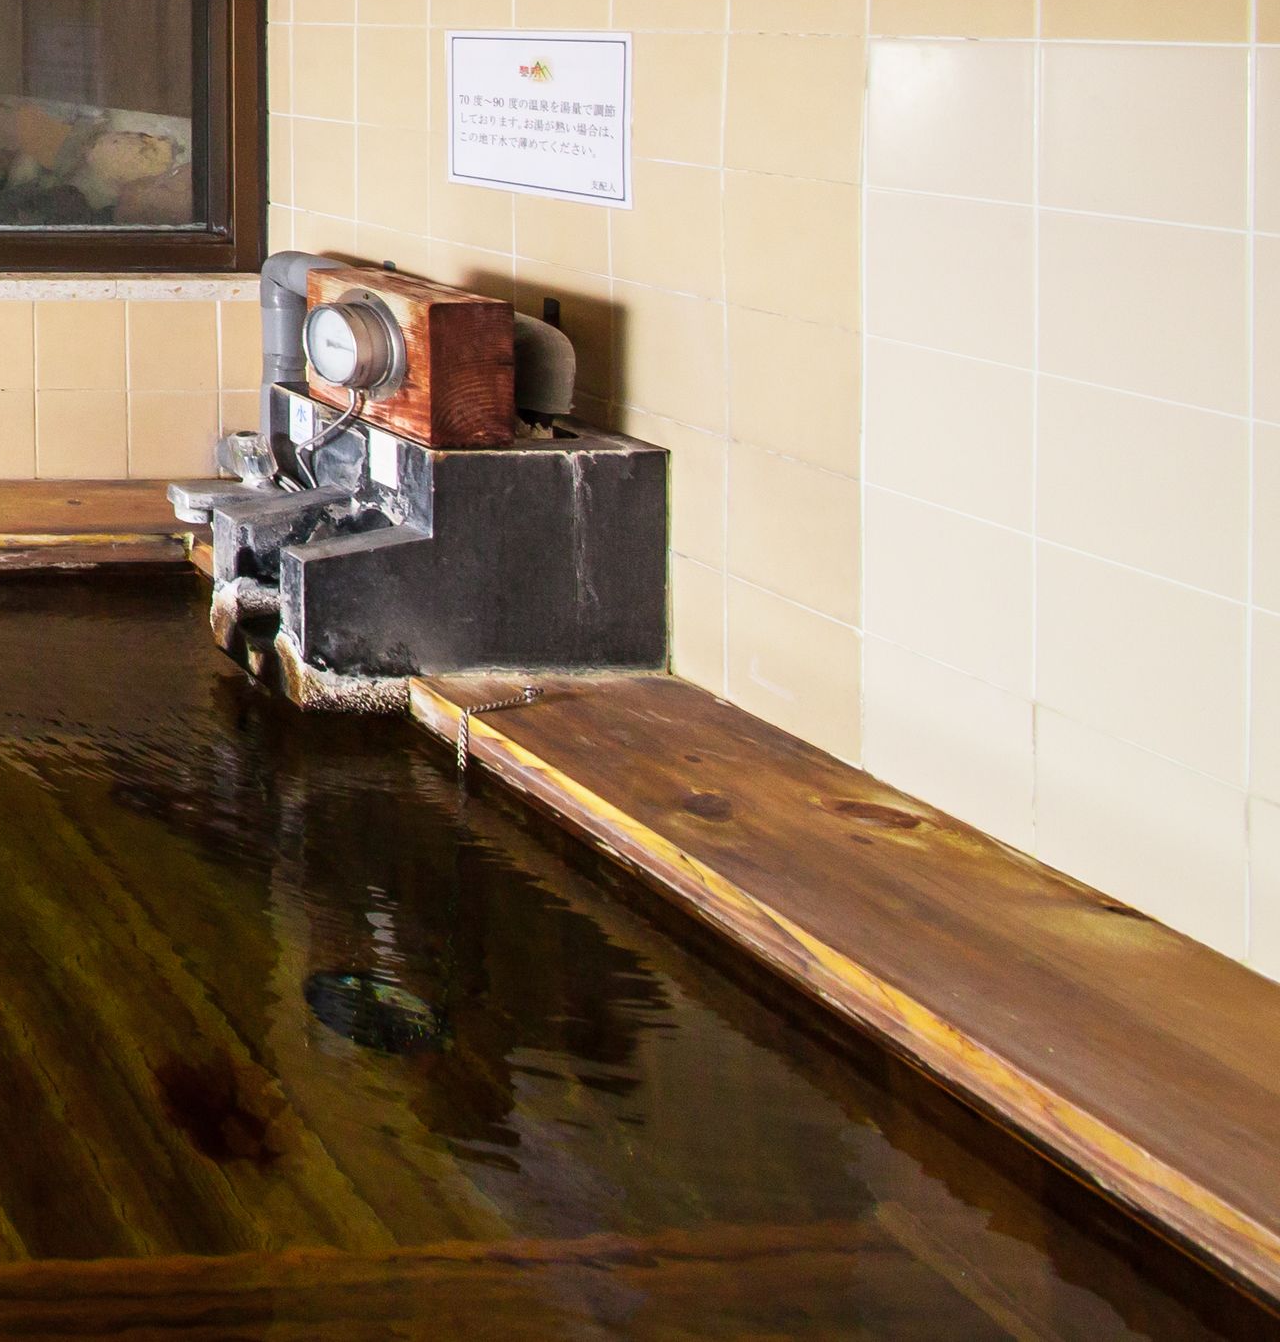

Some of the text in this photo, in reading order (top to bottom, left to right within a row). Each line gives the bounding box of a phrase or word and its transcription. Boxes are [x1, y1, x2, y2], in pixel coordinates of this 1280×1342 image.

[460, 113, 615, 139] しております。お湯が熱い場合は、
[460, 131, 597, 158] この地下水で薄めてください。
[295, 404, 308, 423] 水
